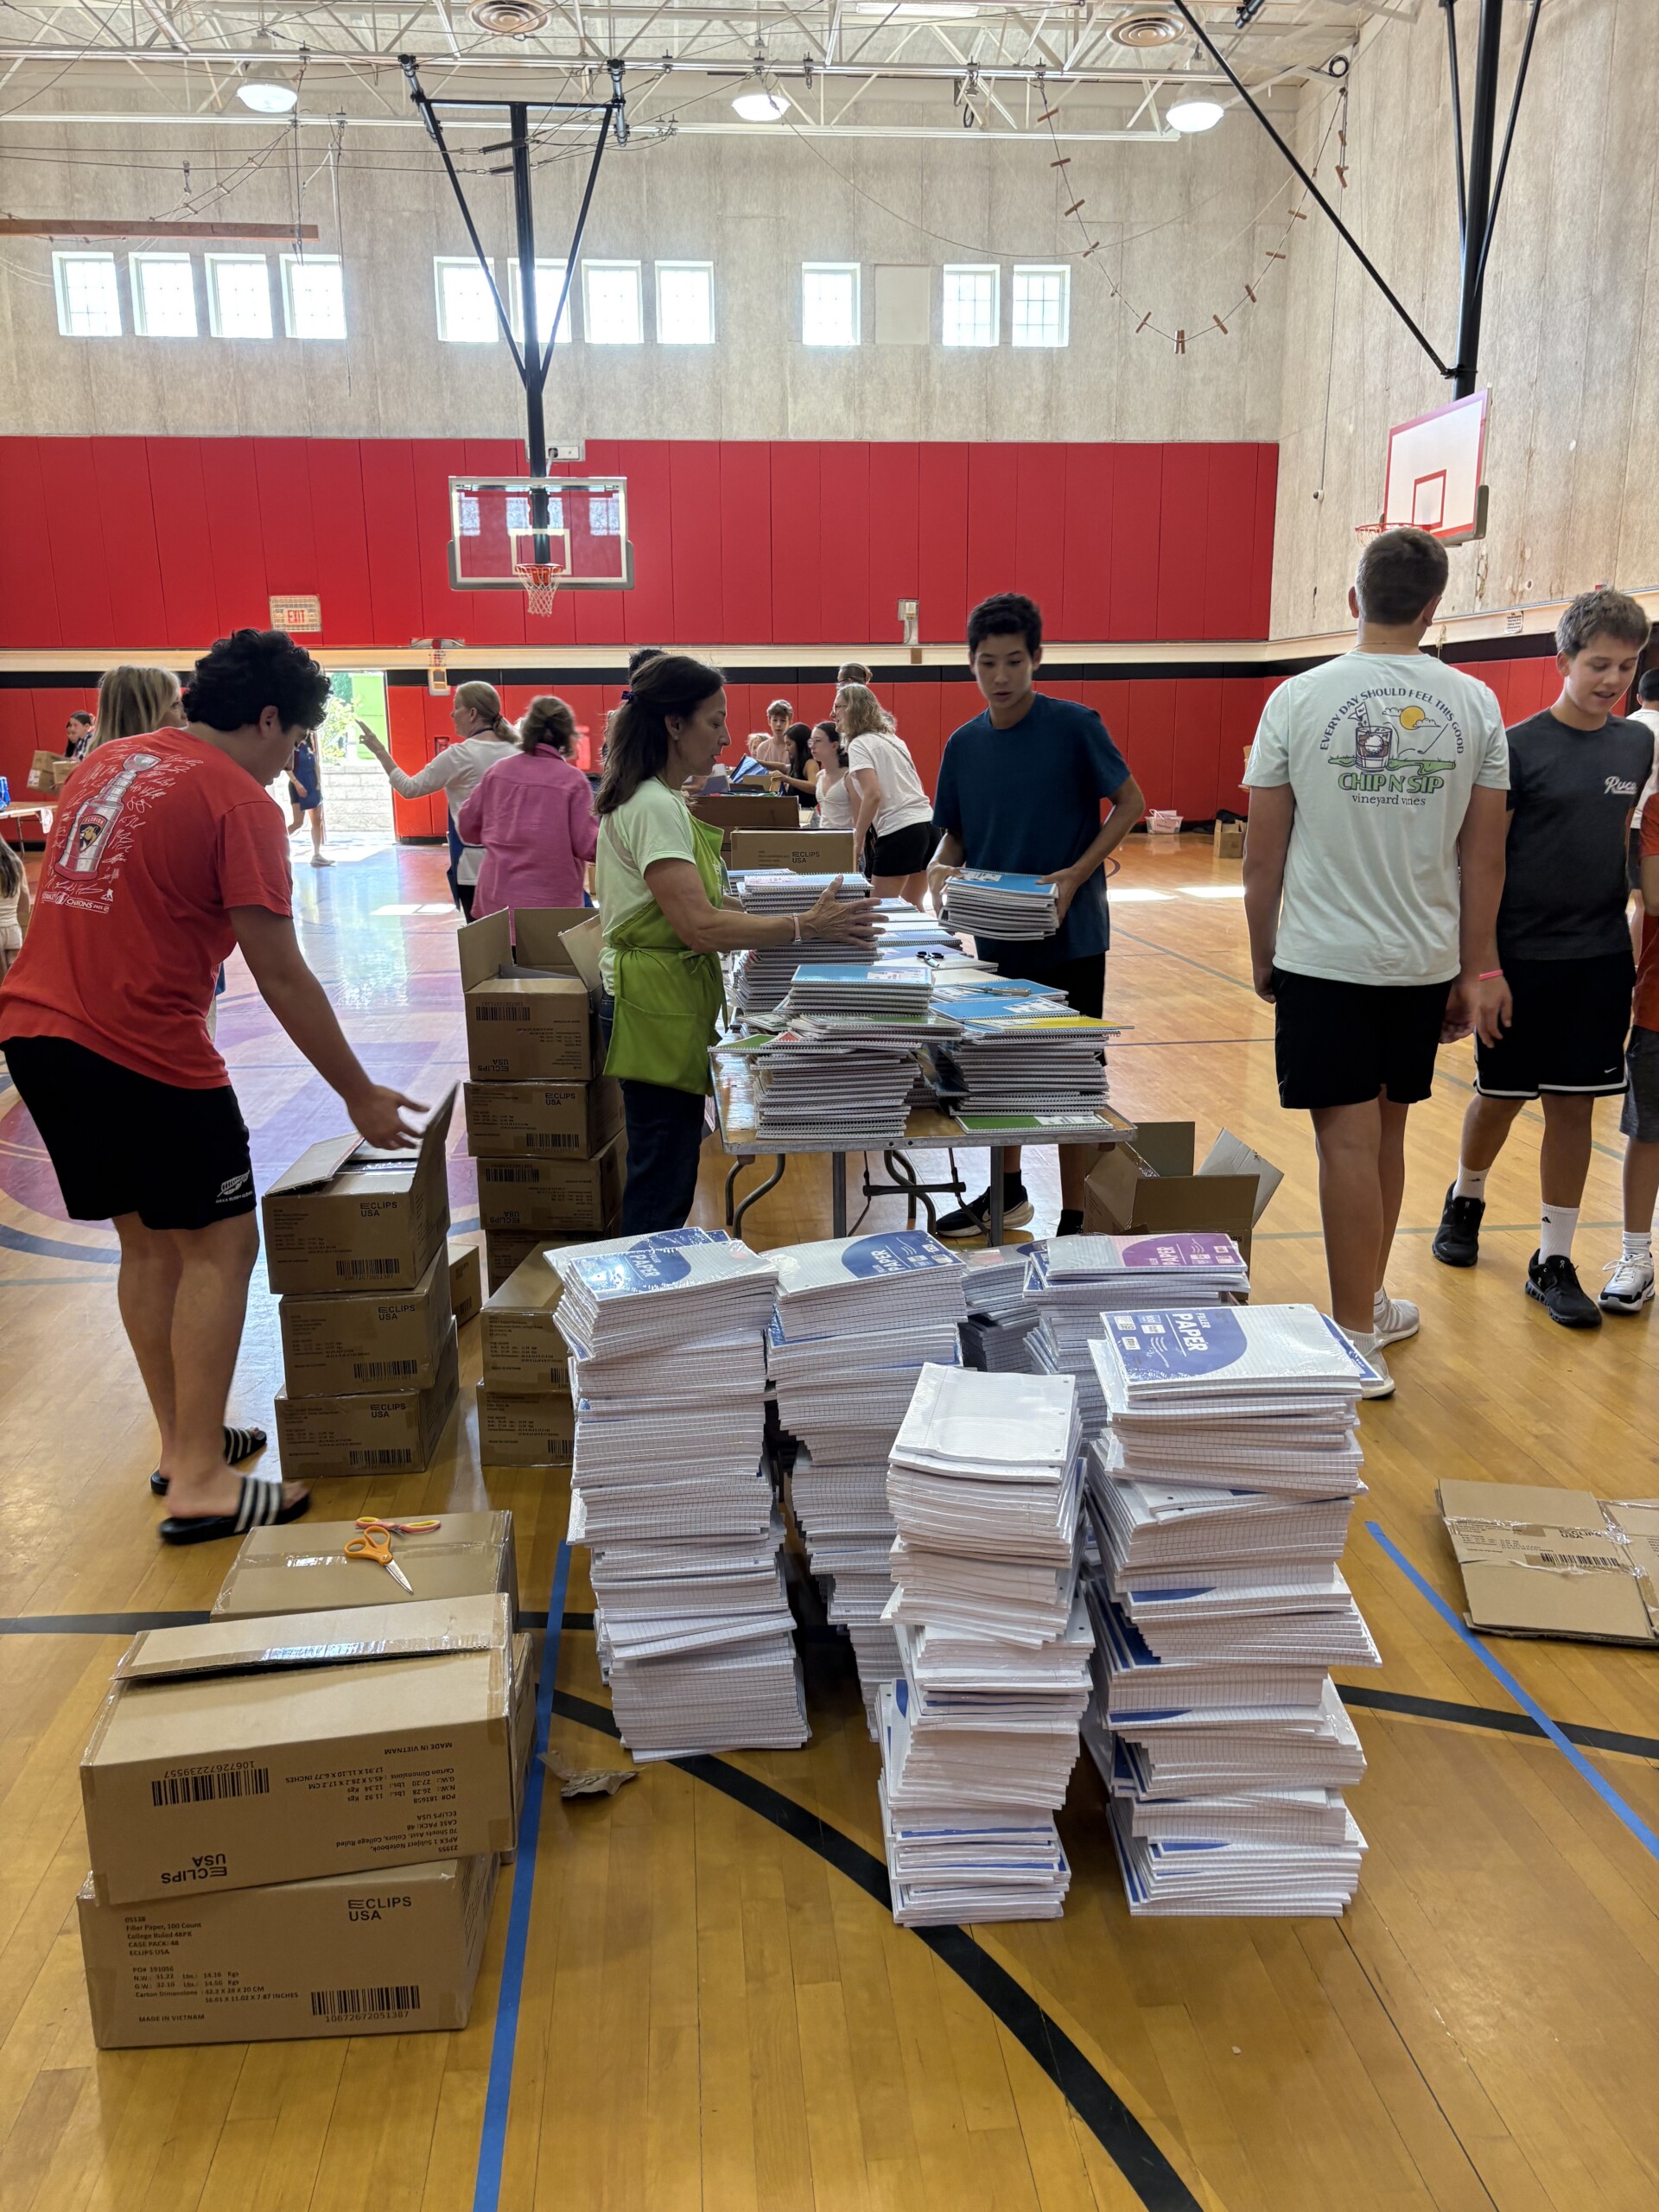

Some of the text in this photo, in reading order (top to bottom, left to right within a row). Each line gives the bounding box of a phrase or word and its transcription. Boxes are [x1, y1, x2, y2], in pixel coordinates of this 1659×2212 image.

[287, 609, 305, 623] EXIT
[1320, 688, 1464, 754] EVERY DAY SHOULD FEEL THIS GOOD
[1338, 772, 1387, 791] CHIP
[1407, 776, 1444, 794] SIP
[1351, 793, 1399, 807] vineyard
[870, 1249, 906, 1272] PAPER
[1156, 1246, 1181, 1266] PAPER
[629, 1254, 661, 1278] PAPER
[378, 1305, 416, 1313] ECLIPS
[378, 1313, 398, 1321] USA
[1195, 1313, 1211, 1329] FILLER
[1172, 1313, 1209, 1351] PAPER
[385, 1745, 419, 1755] VIETNAM
[164, 1760, 255, 1778] 10672672239557
[391, 1770, 430, 1779] Dimensions
[285, 1775, 313, 1783] INCHES
[336, 1840, 356, 1848] Ruled
[357, 1835, 382, 1845] College
[407, 1840, 432, 1848] Subject
[370, 1842, 406, 1853] Notebook,
[192, 1853, 226, 1867] USA
[161, 1866, 228, 1884] ECLIPS
[347, 1897, 412, 1910] ECLIPS
[349, 1910, 382, 1922] USA
[127, 1932, 152, 1941] College
[325, 2011, 410, 2023] 10672672051387
